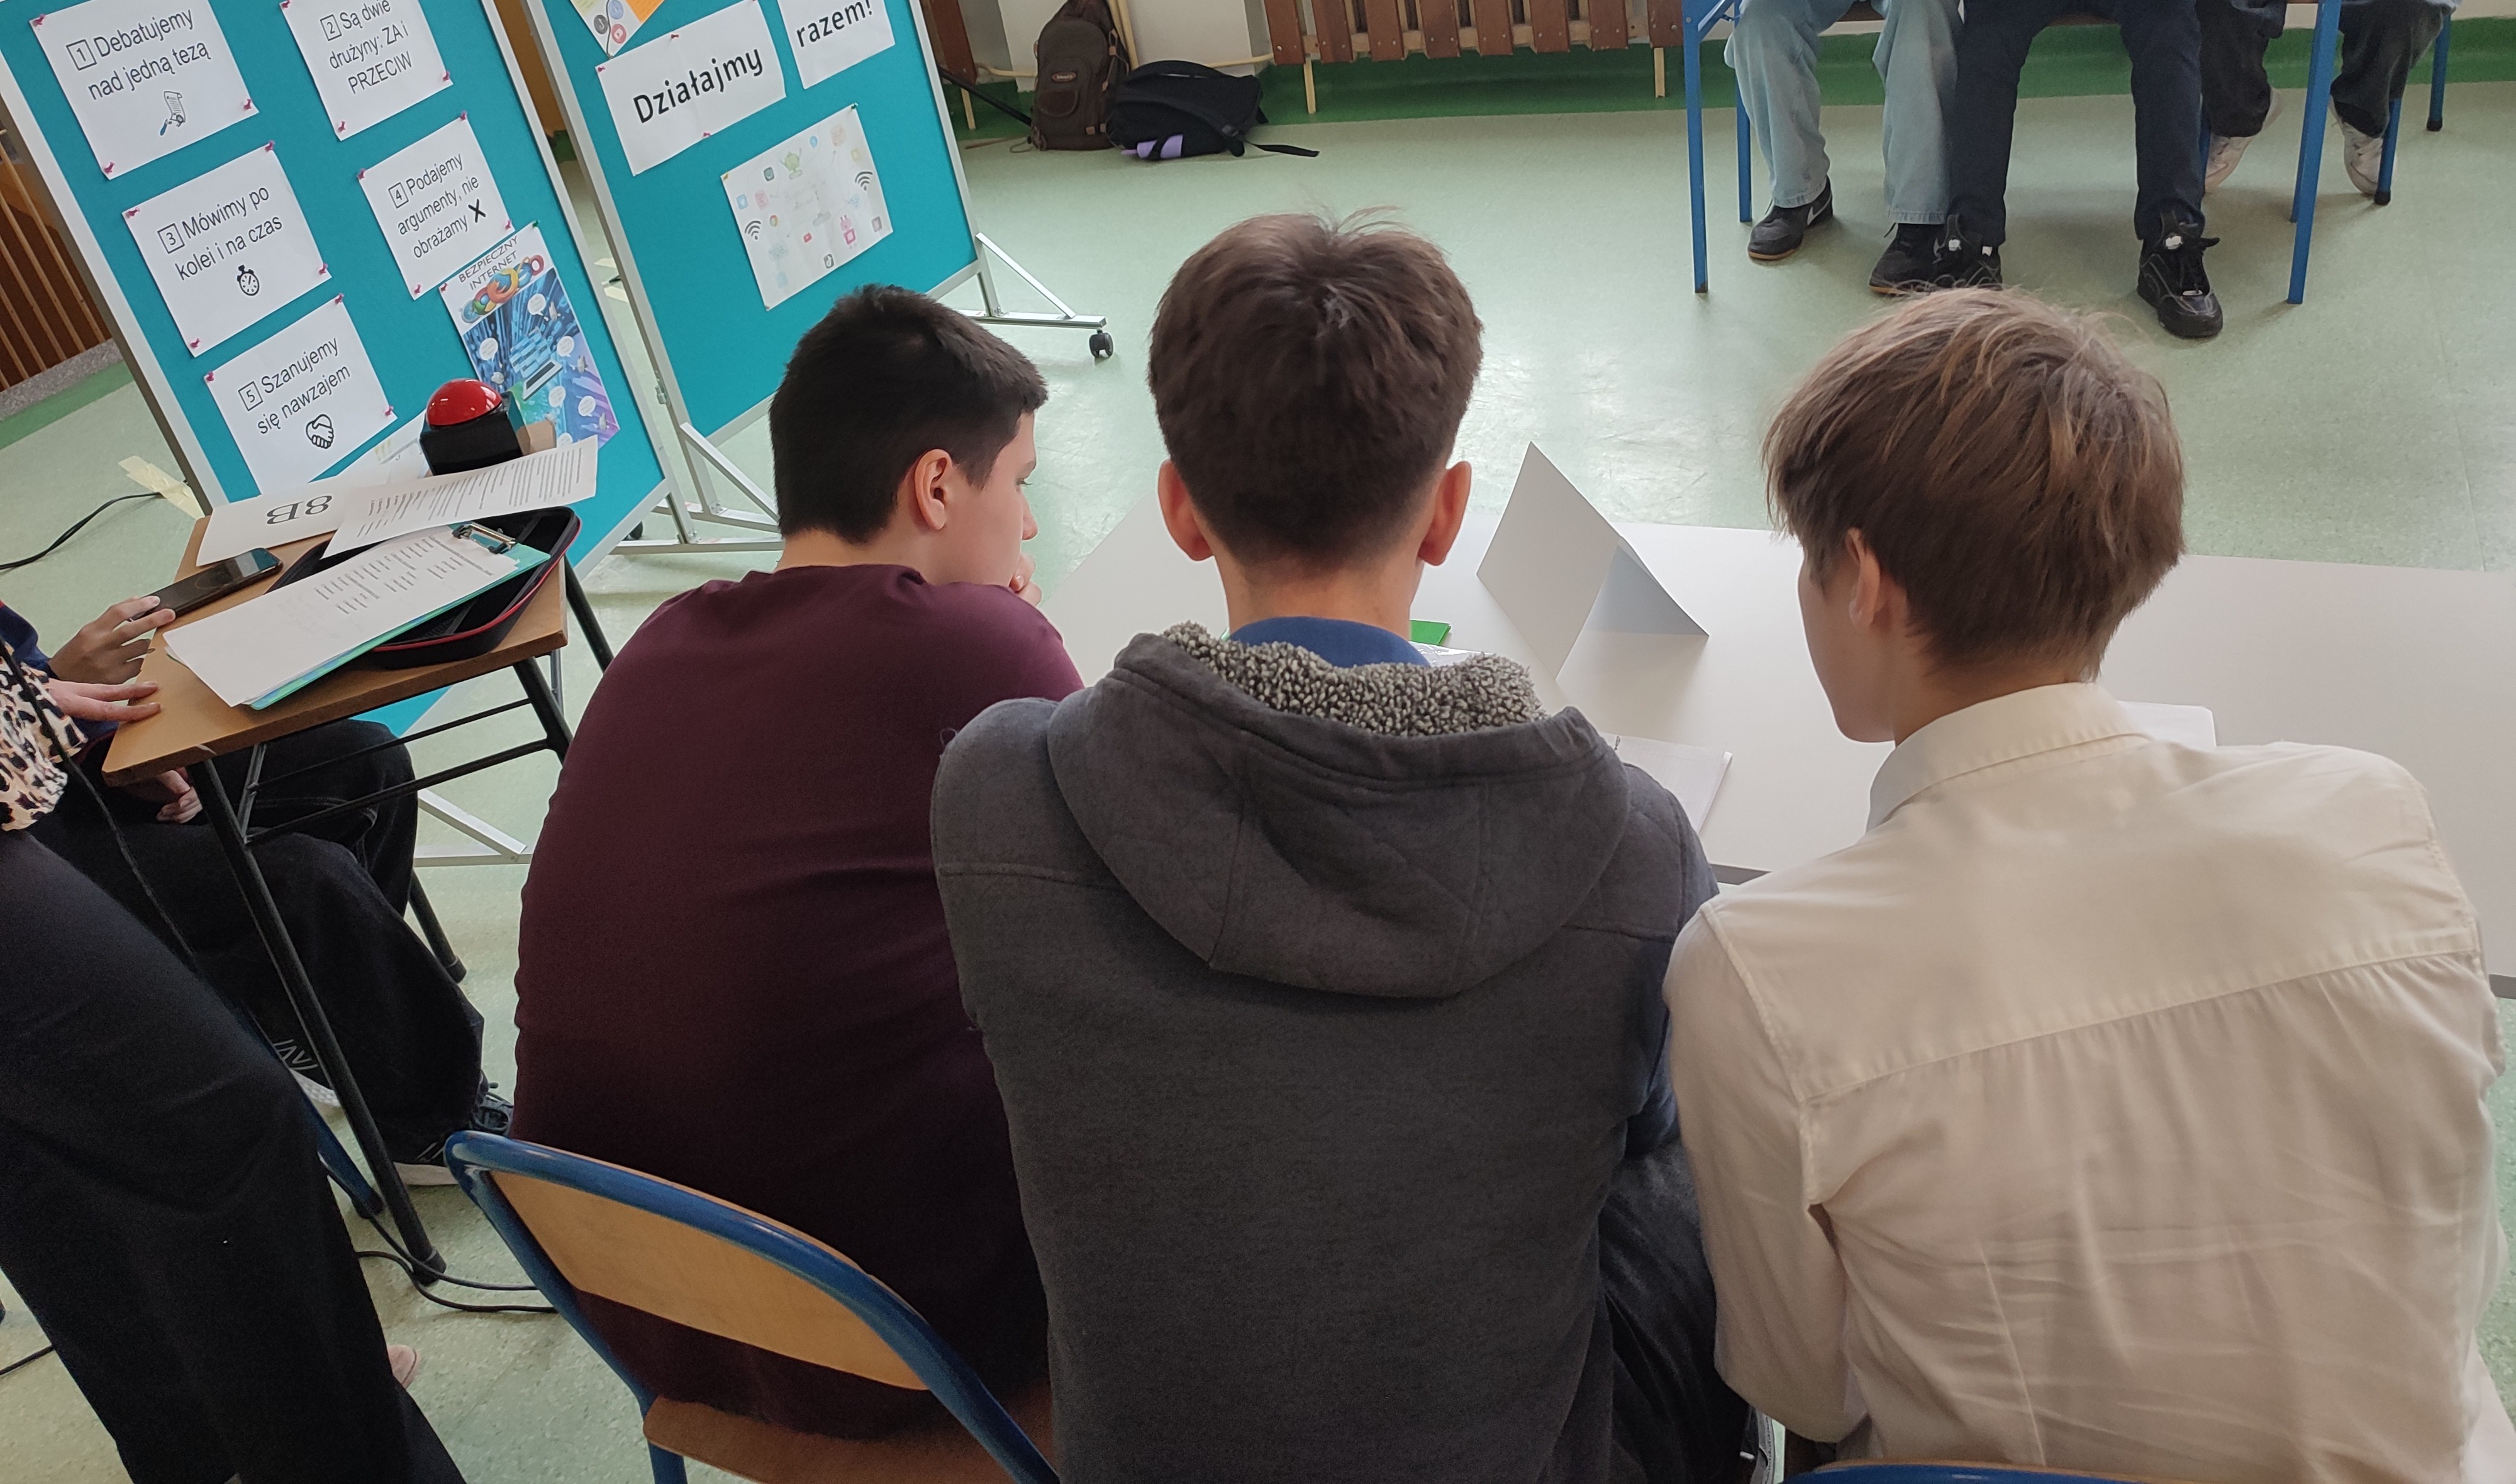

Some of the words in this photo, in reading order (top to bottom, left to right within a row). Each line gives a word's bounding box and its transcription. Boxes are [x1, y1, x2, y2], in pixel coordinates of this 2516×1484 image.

[93, 9, 193, 57] Debatujemy
[340, 12, 363, 29] Są
[362, 0, 391, 21] dwie
[796, 0, 873, 47] razem!
[329, 36, 383, 69] drużyny:
[382, 24, 404, 45] ZA
[401, 20, 409, 36] i
[88, 70, 124, 100] nad
[122, 58, 175, 91] jedną
[172, 42, 211, 66] tezą
[348, 51, 412, 94] PRZECIW
[633, 48, 763, 124] Działajmy
[406, 153, 463, 196] Podajemy
[182, 197, 247, 239] Mówimy
[249, 187, 269, 211] po
[398, 189, 462, 235] argumenty,
[461, 176, 479, 195] nie
[175, 246, 216, 281] kolei
[214, 242, 225, 260] i
[225, 235, 247, 255] na
[248, 216, 282, 242] czas
[413, 214, 468, 258] obrażamy
[459, 235, 518, 283] BEZPIECZNY
[469, 250, 516, 291] INTERNET
[261, 337, 338, 393] Szanujemy
[258, 414, 281, 434] się
[281, 366, 350, 419] nawzajem
